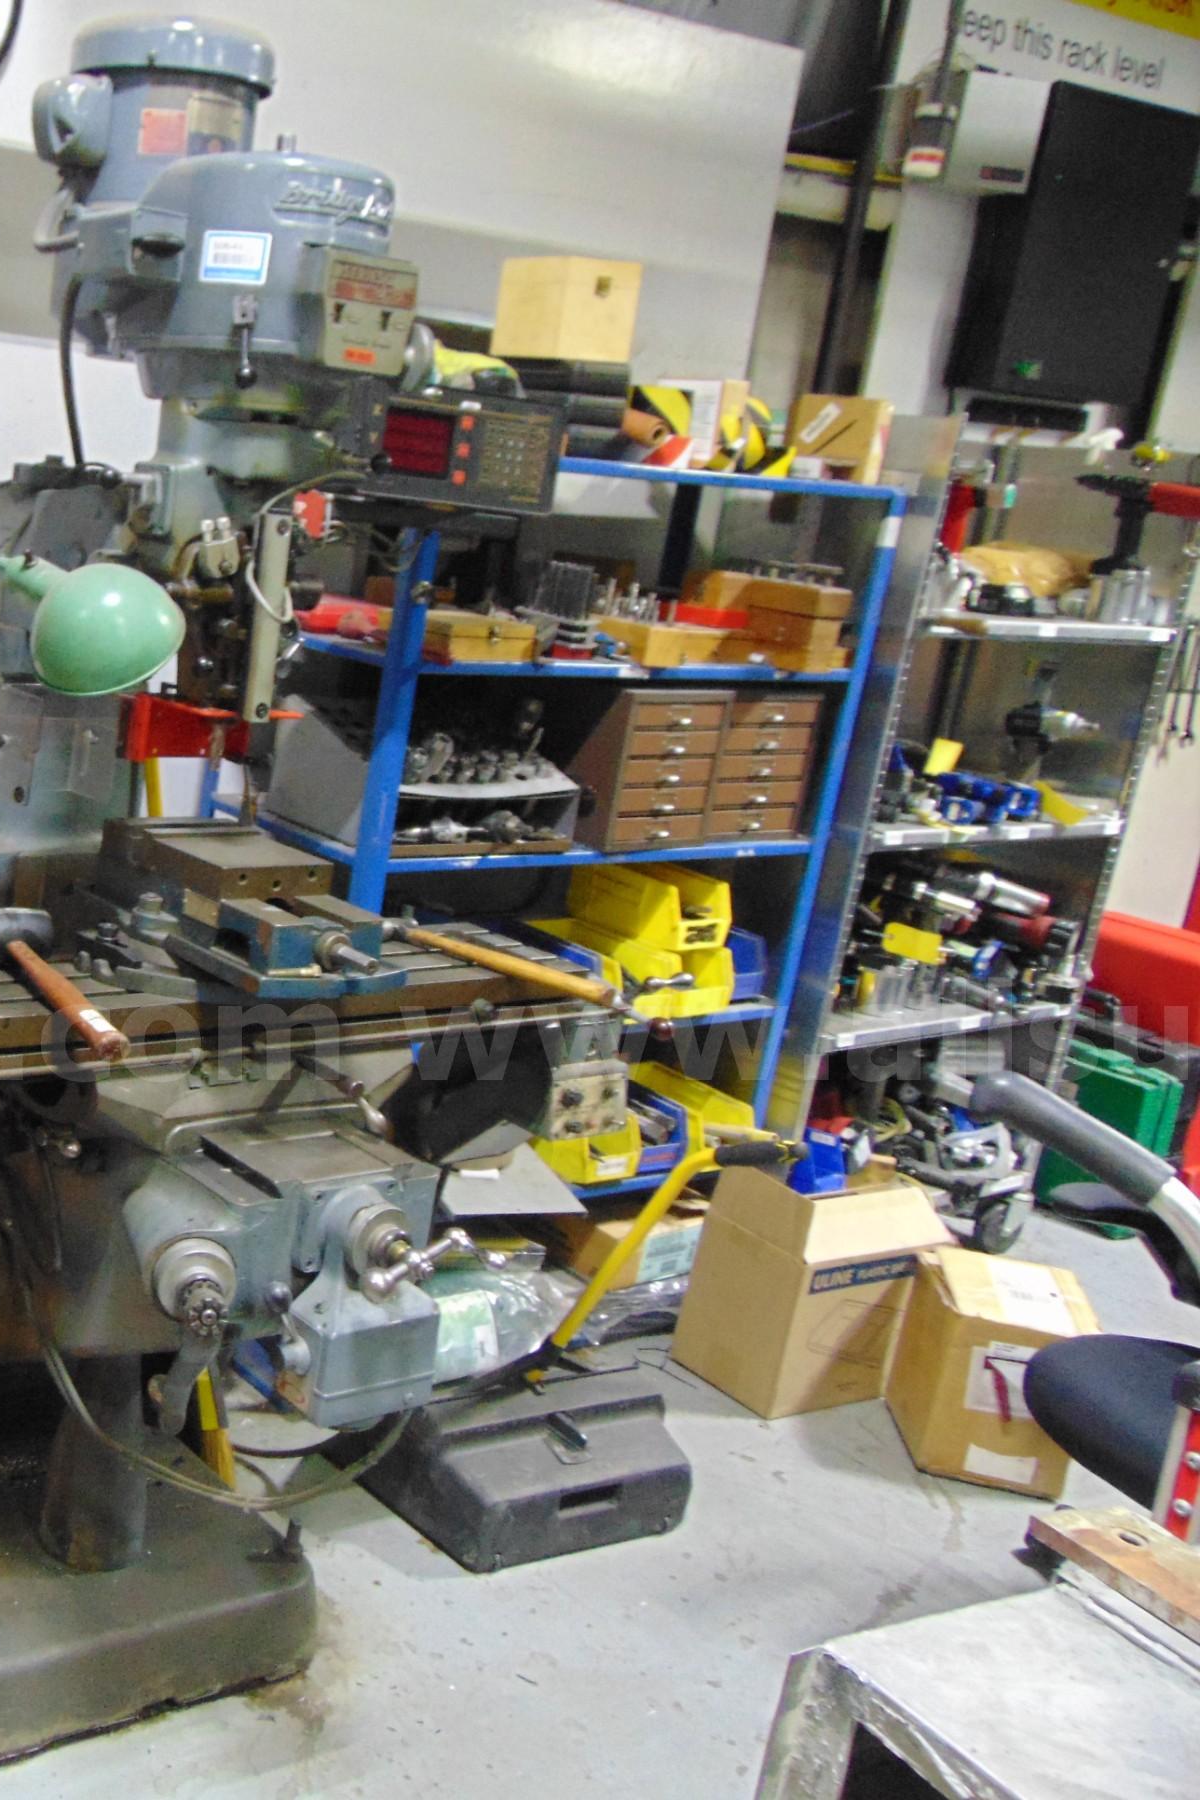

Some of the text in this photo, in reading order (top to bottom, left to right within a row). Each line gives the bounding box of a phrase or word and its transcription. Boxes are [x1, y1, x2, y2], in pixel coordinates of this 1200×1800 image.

[962, 9, 1166, 90] eep this rack level
[812, 1267, 855, 1291] ULINE
